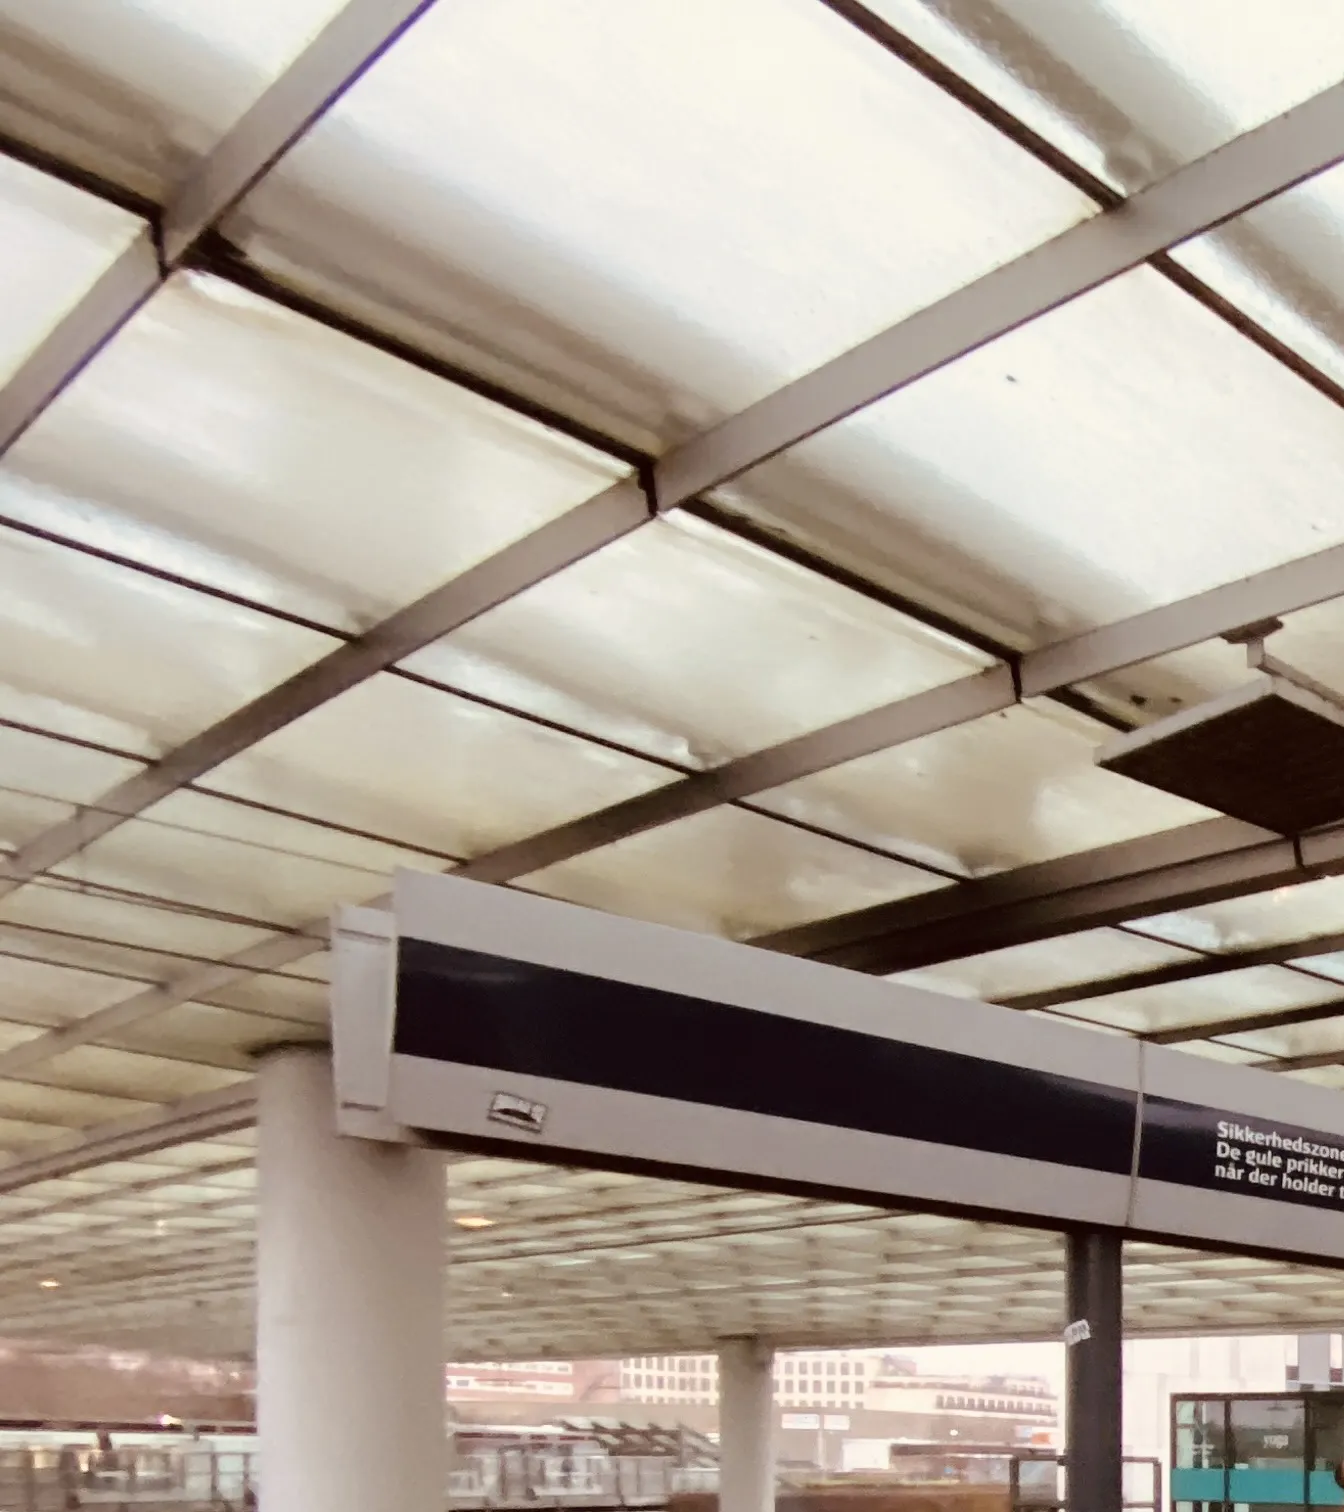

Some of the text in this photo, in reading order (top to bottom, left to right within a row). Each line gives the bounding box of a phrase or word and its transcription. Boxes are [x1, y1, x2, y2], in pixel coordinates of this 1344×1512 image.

[1216, 1141, 1241, 1161] De
[1245, 1147, 1282, 1168] gule
[1286, 1155, 1344, 1180] prikker
[1214, 1162, 1245, 1181] når
[1248, 1165, 1278, 1187] der
[1281, 1173, 1336, 1198] holder
